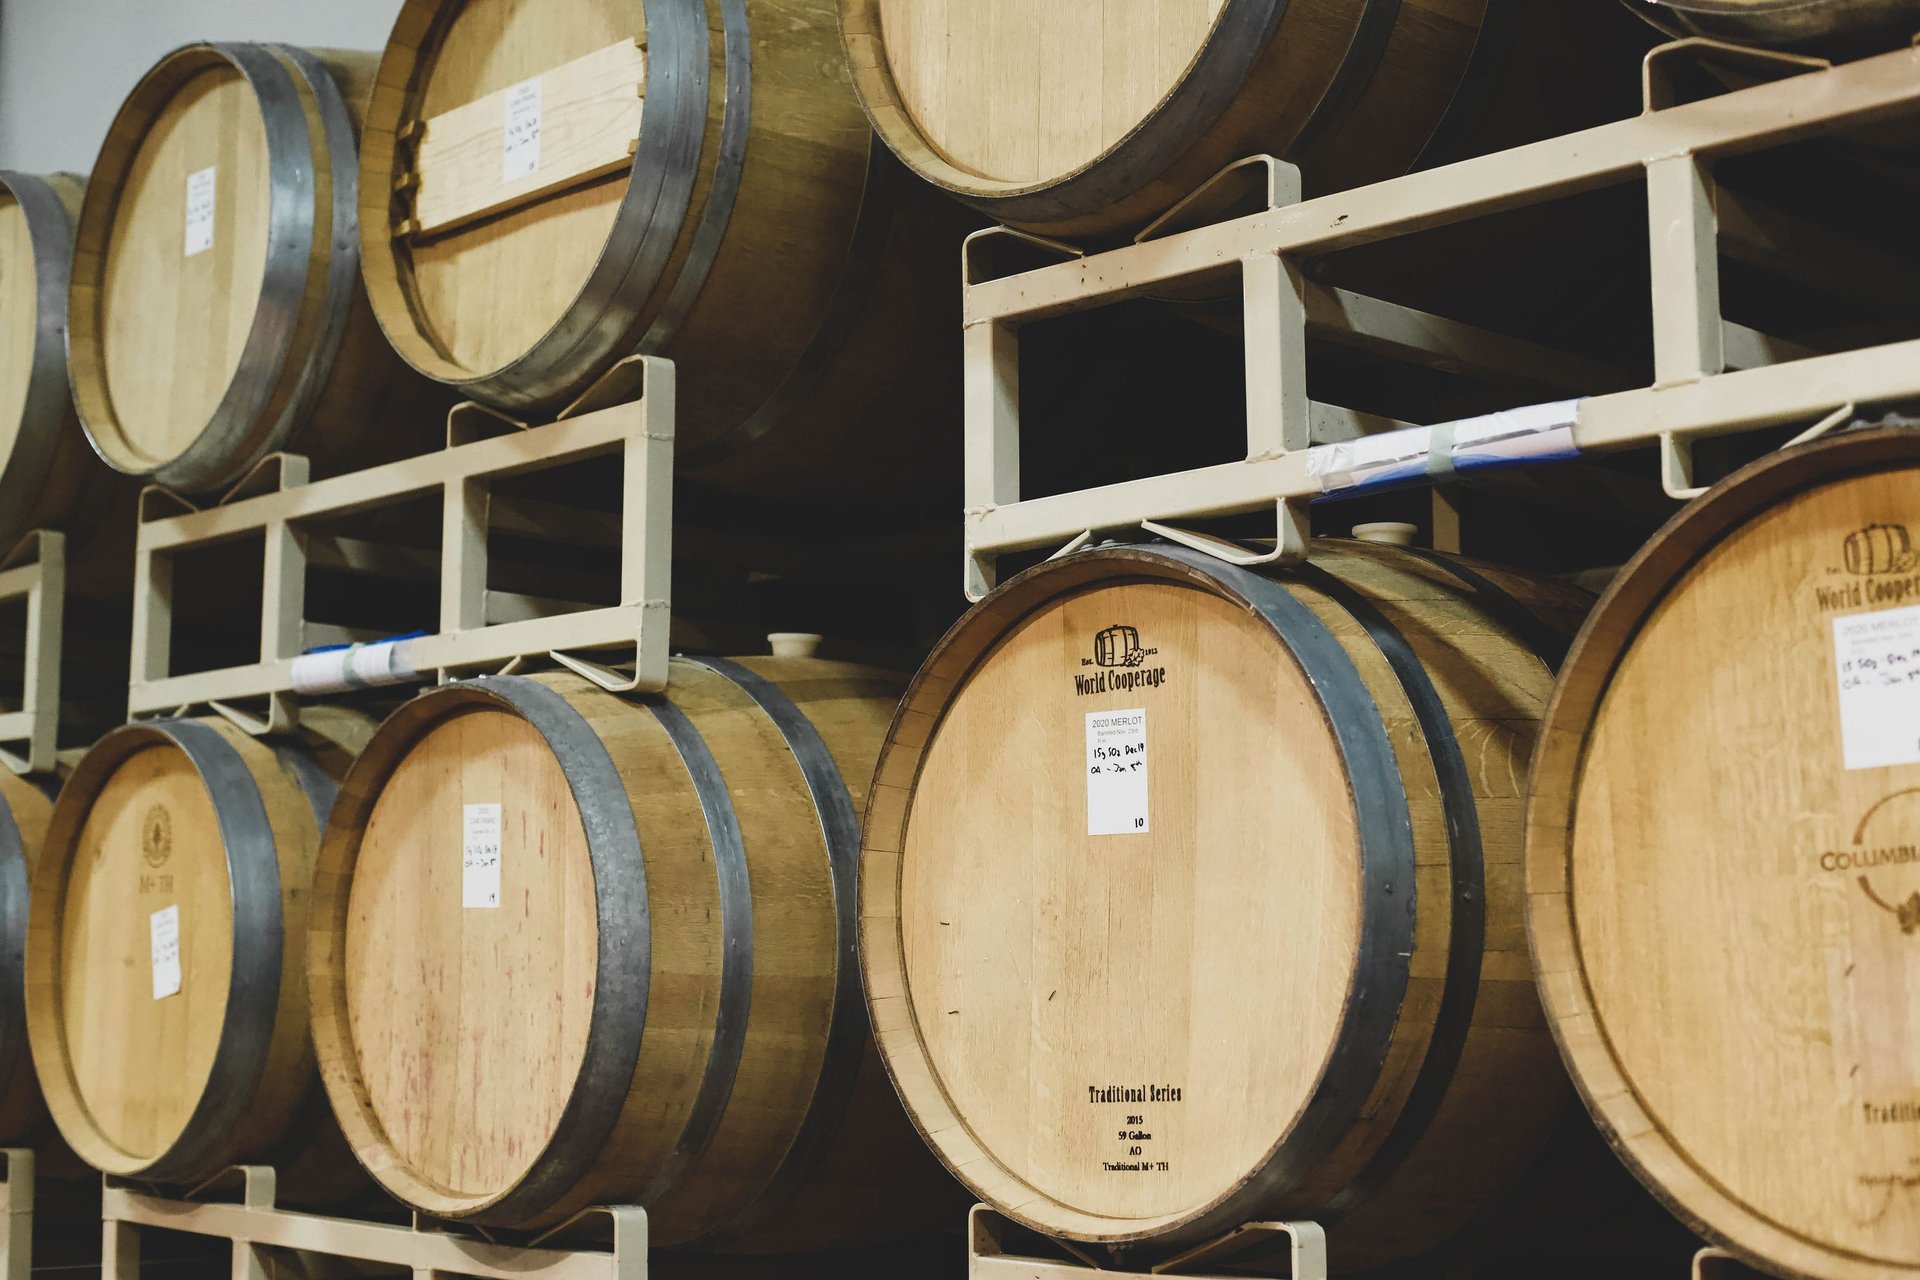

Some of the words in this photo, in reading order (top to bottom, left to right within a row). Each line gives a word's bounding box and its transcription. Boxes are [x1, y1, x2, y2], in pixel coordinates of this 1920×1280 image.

[1816, 581, 1861, 612] World
[1074, 671, 1106, 697] World
[1108, 667, 1166, 692] Cooperage
[1092, 719, 1109, 728] 2020
[1111, 716, 1143, 726] MERLOT
[1134, 817, 1144, 828] 10
[1820, 845, 1920, 871] COLUMBI
[1088, 1084, 1146, 1103] Traditional
[1150, 1084, 1182, 1102] Series
[1126, 1115, 1143, 1125] 2015
[1118, 1131, 1127, 1140] 59
[1129, 1130, 1152, 1140] Gallon
[1129, 1146, 1142, 1155] AO
[1103, 1162, 1140, 1171] Traditional
[1142, 1162, 1154, 1171] M+
[1156, 1162, 1169, 1171] TH
